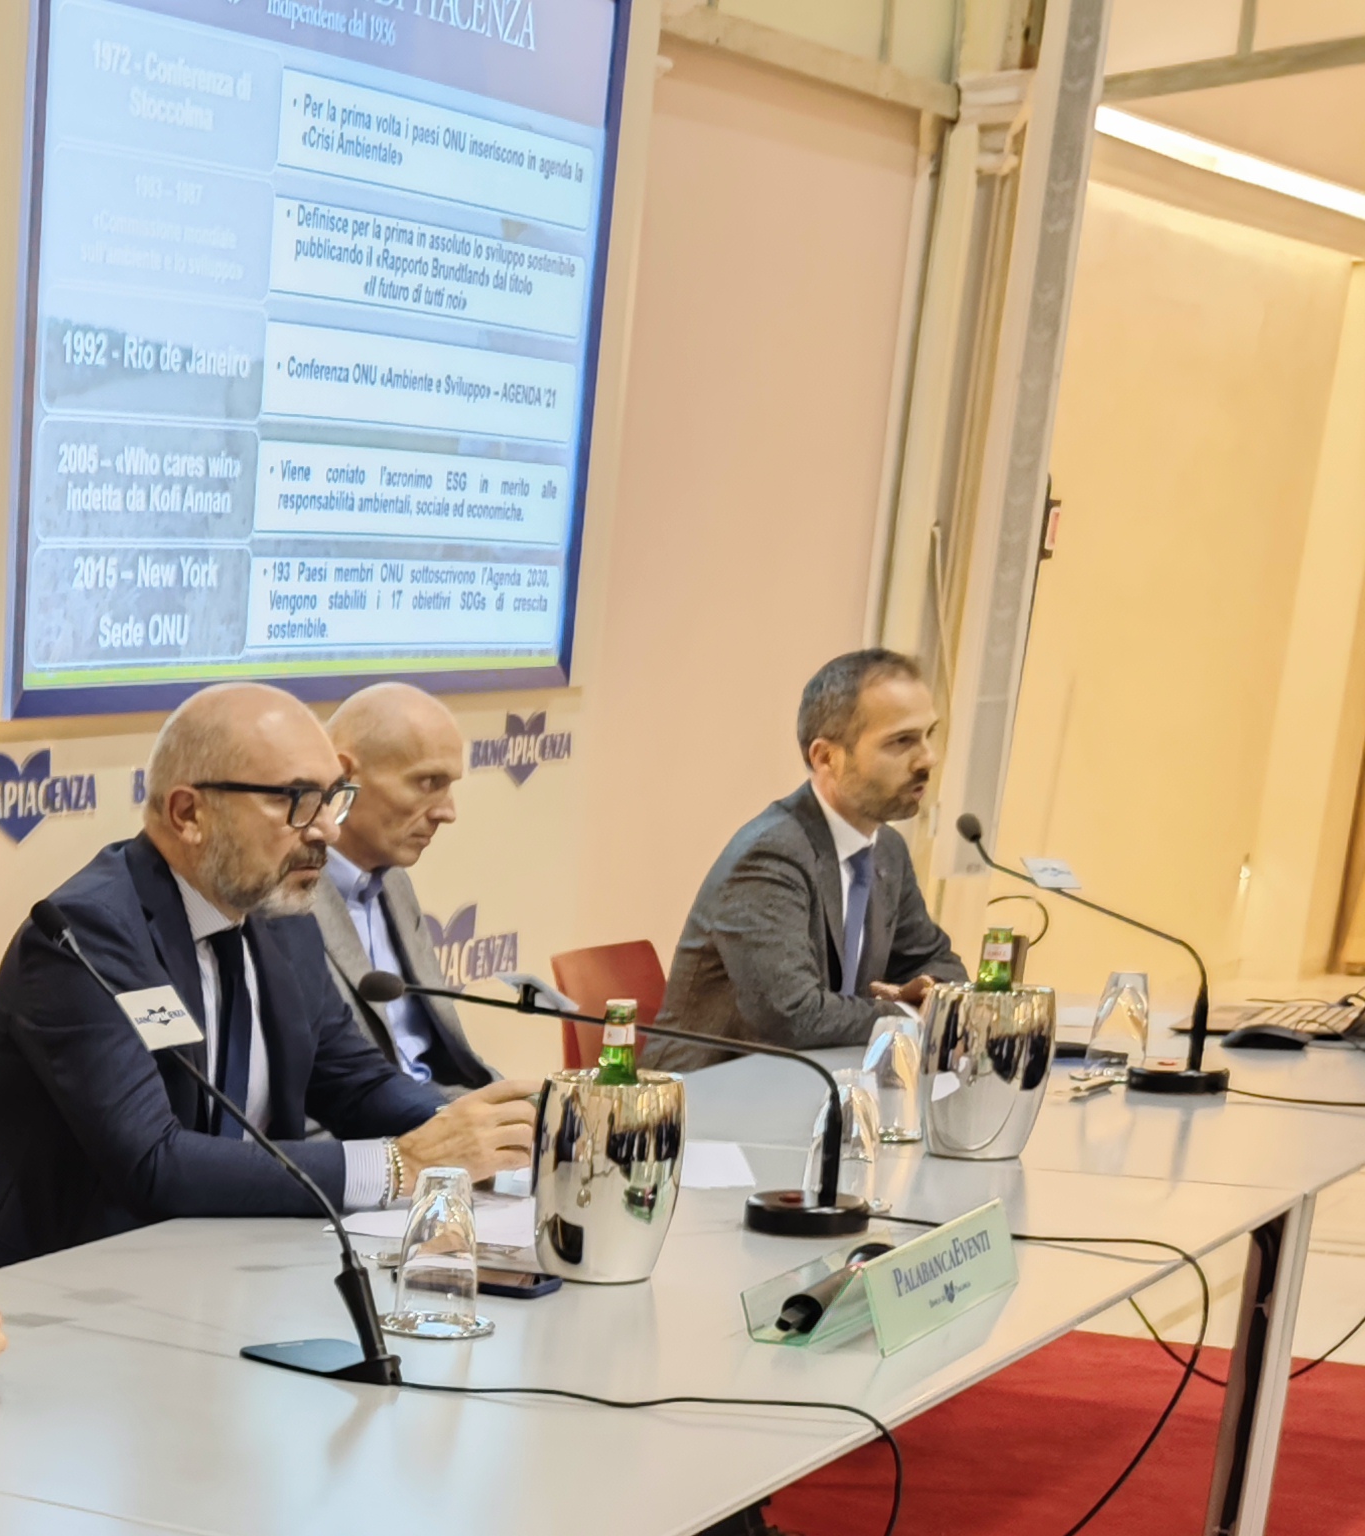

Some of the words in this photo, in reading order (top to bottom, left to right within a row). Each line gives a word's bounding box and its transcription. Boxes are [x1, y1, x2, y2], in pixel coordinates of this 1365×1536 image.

[348, 8, 366, 39] dal
[369, 15, 396, 47] 1936
[92, 39, 131, 75] 1972
[144, 50, 234, 98] Conferenza
[236, 70, 252, 102] di
[129, 85, 215, 132] Stoccolma
[302, 125, 335, 151] «Crisi
[336, 132, 403, 166] Ambientale»
[303, 93, 323, 119] Per
[326, 98, 336, 122] la
[340, 104, 371, 130] prima
[376, 113, 401, 137] volta
[412, 124, 440, 147] paesi
[442, 127, 467, 152] ONU
[469, 134, 525, 167] inseriscono
[527, 149, 537, 171] in
[539, 156, 572, 181] agenda
[575, 162, 584, 183] la
[297, 204, 349, 234] Definisce
[351, 219, 370, 240] per
[372, 218, 381, 240] la
[384, 222, 414, 246] prima
[416, 226, 426, 250] in
[429, 233, 472, 257] assoluto
[473, 238, 483, 260] lo
[485, 242, 525, 270] sviluppo
[527, 254, 576, 279] sostenibile
[294, 235, 364, 266] pubblicando
[366, 245, 373, 267] il
[376, 248, 429, 278] «Rapporto
[431, 257, 490, 287] Brundtland»
[492, 268, 507, 293] dal
[509, 272, 533, 297] titolo
[378, 277, 410, 301] futuro
[412, 282, 423, 304] di
[424, 286, 444, 308] tutti
[445, 290, 468, 311] noi»
[63, 330, 108, 366] 1992
[123, 336, 153, 371] Rio
[159, 340, 183, 374] de
[186, 343, 252, 379] Janeiro
[287, 356, 350, 384] Conferenza
[352, 363, 378, 386] ONU
[380, 367, 433, 394] «Ambiente
[436, 378, 442, 393] e
[444, 374, 491, 403] Sviluppo»
[500, 382, 542, 407] AGENDA
[115, 446, 160, 476] «Who
[163, 453, 206, 478] cares
[208, 451, 242, 479] win»
[280, 459, 311, 482] Viene
[325, 463, 366, 485] coniato
[380, 466, 433, 489] l'acronimo
[446, 471, 467, 491] ESG
[479, 473, 489, 493] in
[501, 477, 530, 497] merito
[541, 480, 557, 499] alle
[67, 481, 124, 512] indetta
[126, 482, 146, 512] da
[149, 484, 182, 512] Kofi
[183, 484, 232, 513] Annan
[278, 490, 355, 515] responsabilità
[358, 492, 412, 517] ambientali,
[416, 496, 449, 517] sociale
[452, 498, 465, 518] ed
[467, 501, 524, 522] economiche.
[72, 555, 118, 590] 2015
[136, 556, 177, 588] New
[180, 555, 219, 588] York
[272, 561, 290, 582] 193
[297, 561, 327, 583] Paesi
[334, 562, 374, 583] membri
[380, 563, 404, 583] ONU
[410, 565, 476, 584] sottoscrivono
[269, 588, 318, 616] Vengono
[328, 589, 367, 610] stabiliti
[391, 589, 403, 610] 17
[412, 591, 451, 610] obiettivi
[460, 591, 486, 611] SDGs
[495, 592, 505, 612] di
[513, 594, 548, 613] crescita
[98, 613, 145, 648] Sede
[148, 612, 189, 646] ONU
[267, 616, 329, 640] sostenibile.
[470, 731, 571, 769] BANCAPIACENZA
